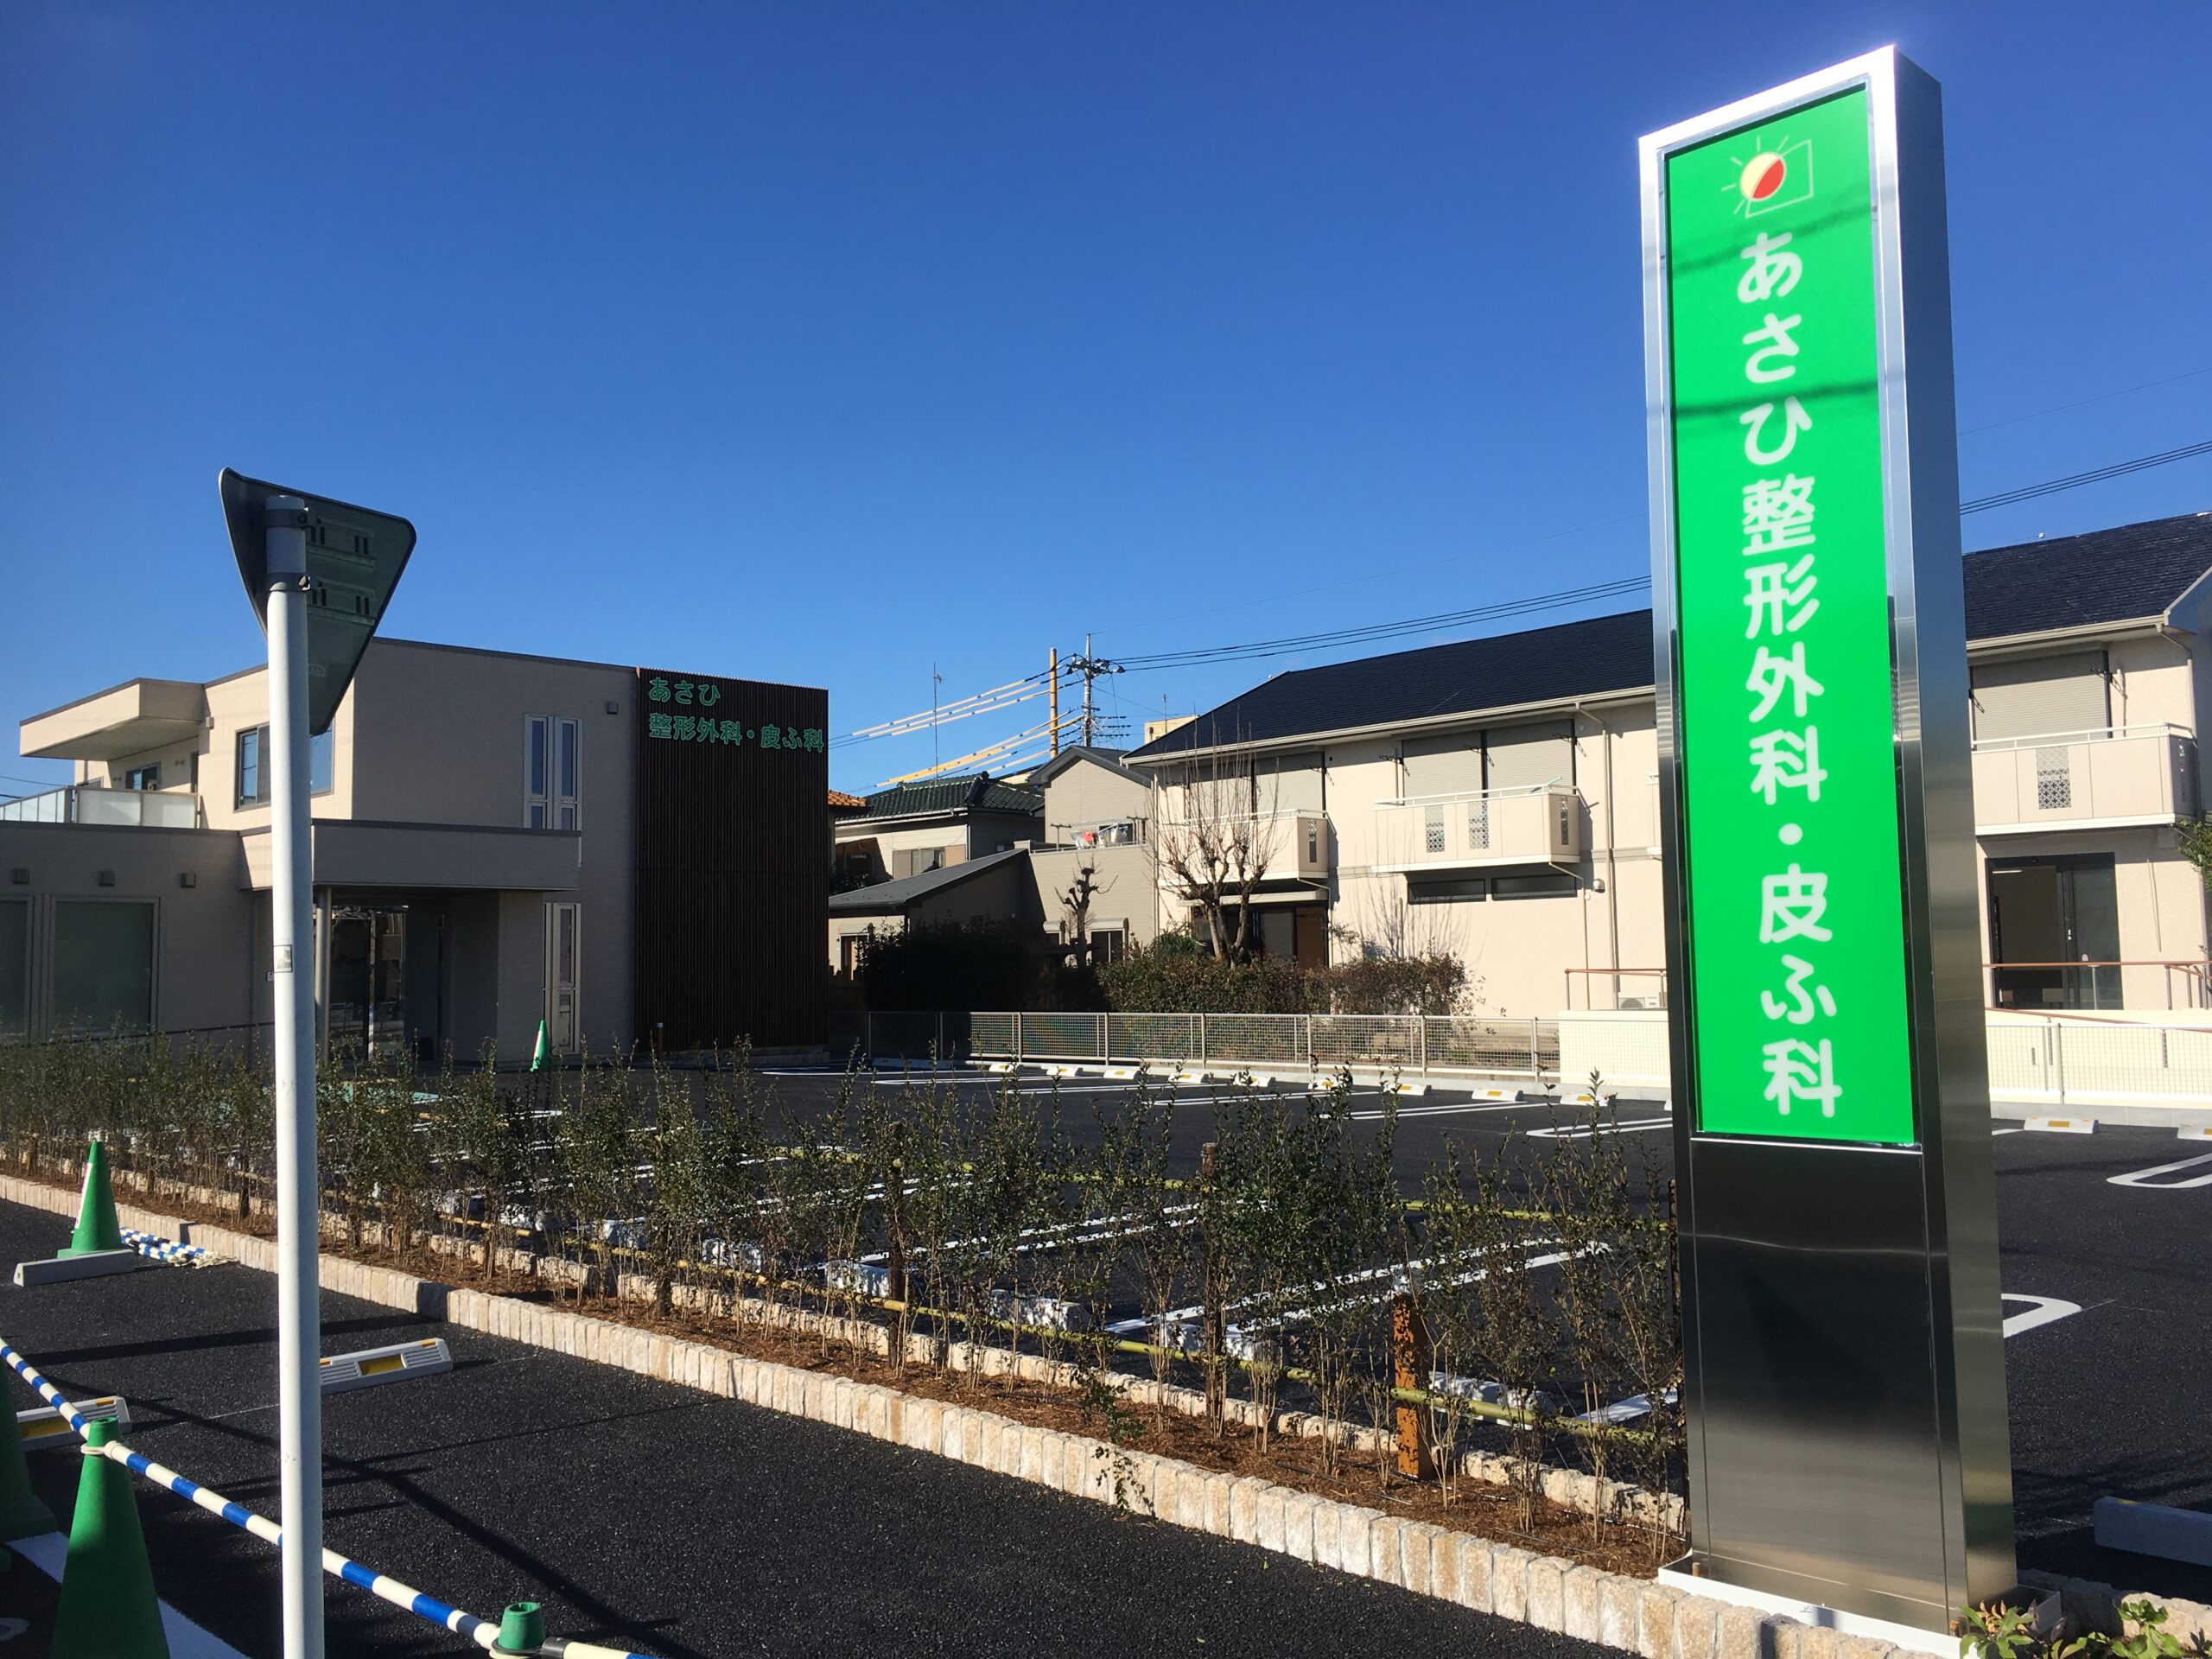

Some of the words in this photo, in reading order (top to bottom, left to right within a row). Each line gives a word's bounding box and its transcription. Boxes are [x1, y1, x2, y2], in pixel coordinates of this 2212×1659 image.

[649, 677, 721, 706] あさひ
[1737, 232, 1842, 1117] あさひ整形外科・皮ふ科
[649, 713, 824, 753] 整形外科・皮ふ科
